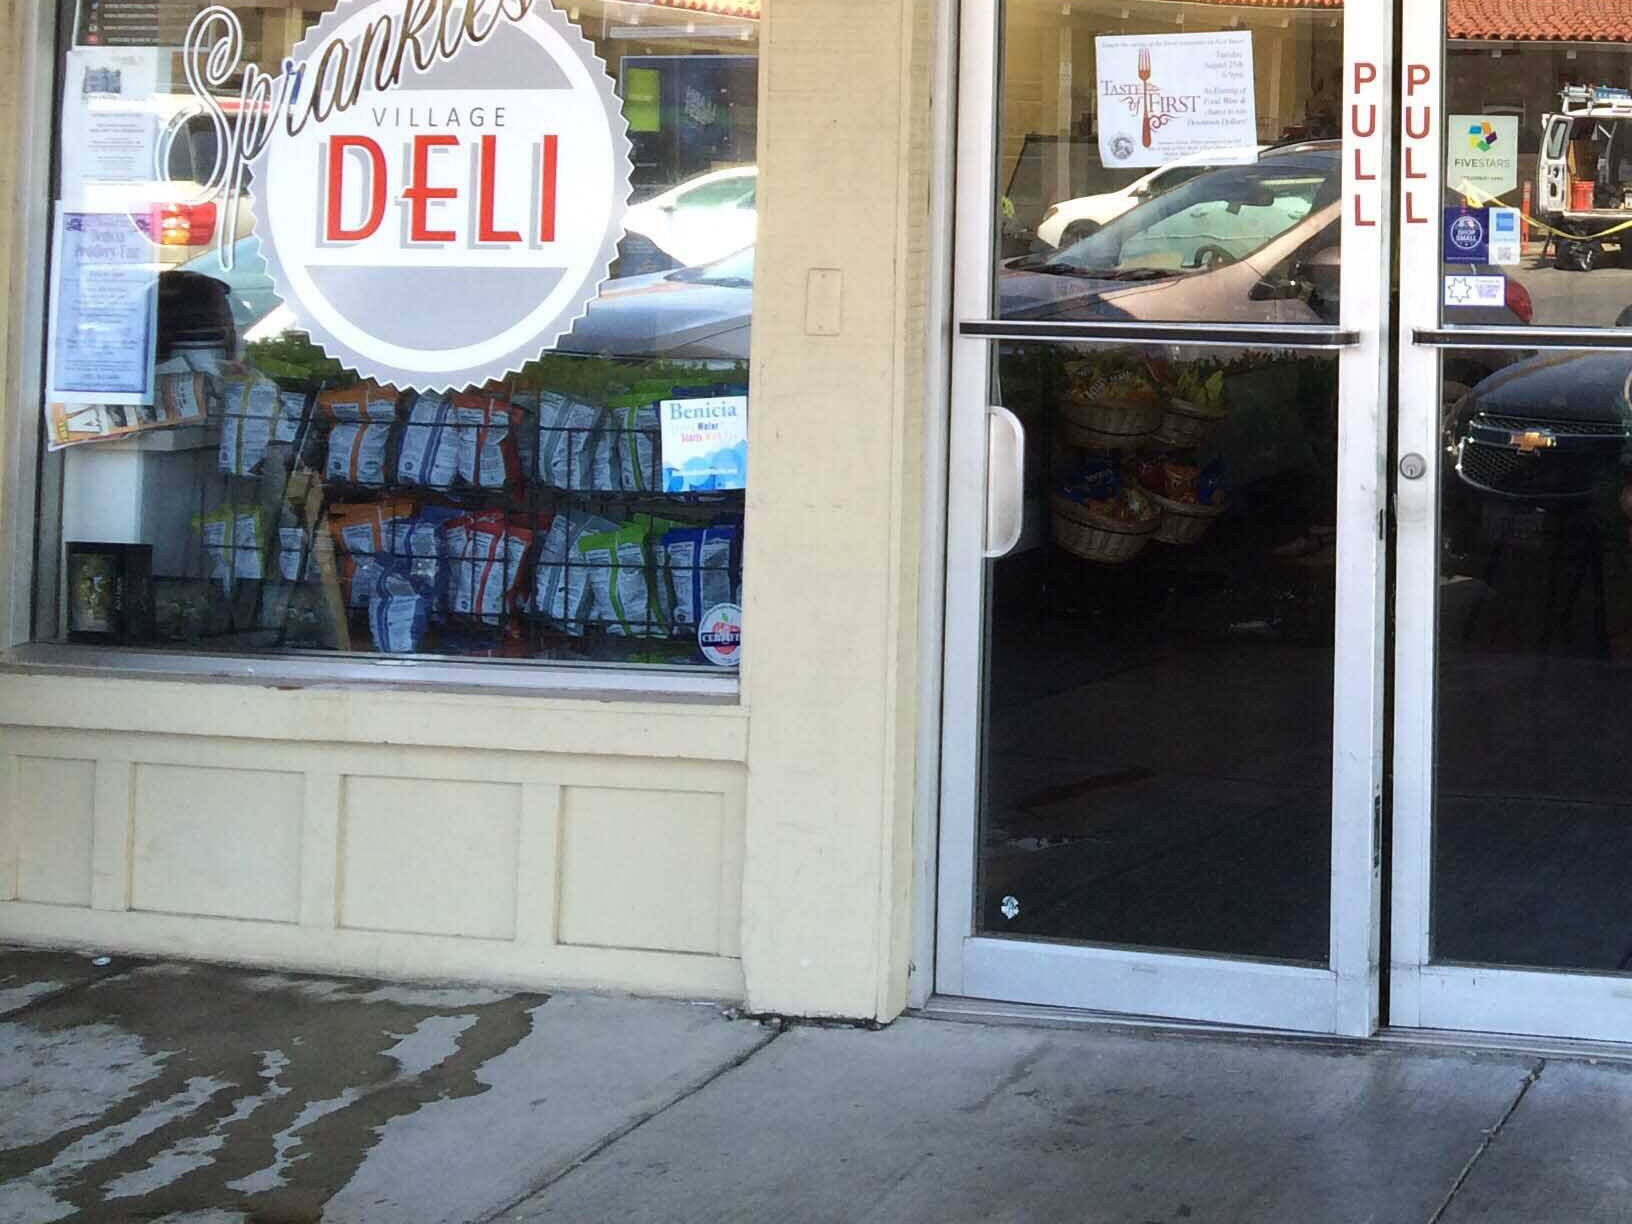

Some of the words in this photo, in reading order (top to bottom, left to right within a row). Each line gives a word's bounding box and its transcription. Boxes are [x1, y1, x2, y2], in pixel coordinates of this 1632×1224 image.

[1149, 93, 1201, 113] FIRST
[373, 106, 508, 129] VILLAGE
[1352, 62, 1377, 227] PULL
[1405, 64, 1431, 224] PULL
[1454, 158, 1511, 168] FIVESTARS
[320, 133, 560, 246] DELI
[670, 401, 737, 420] Benicia
